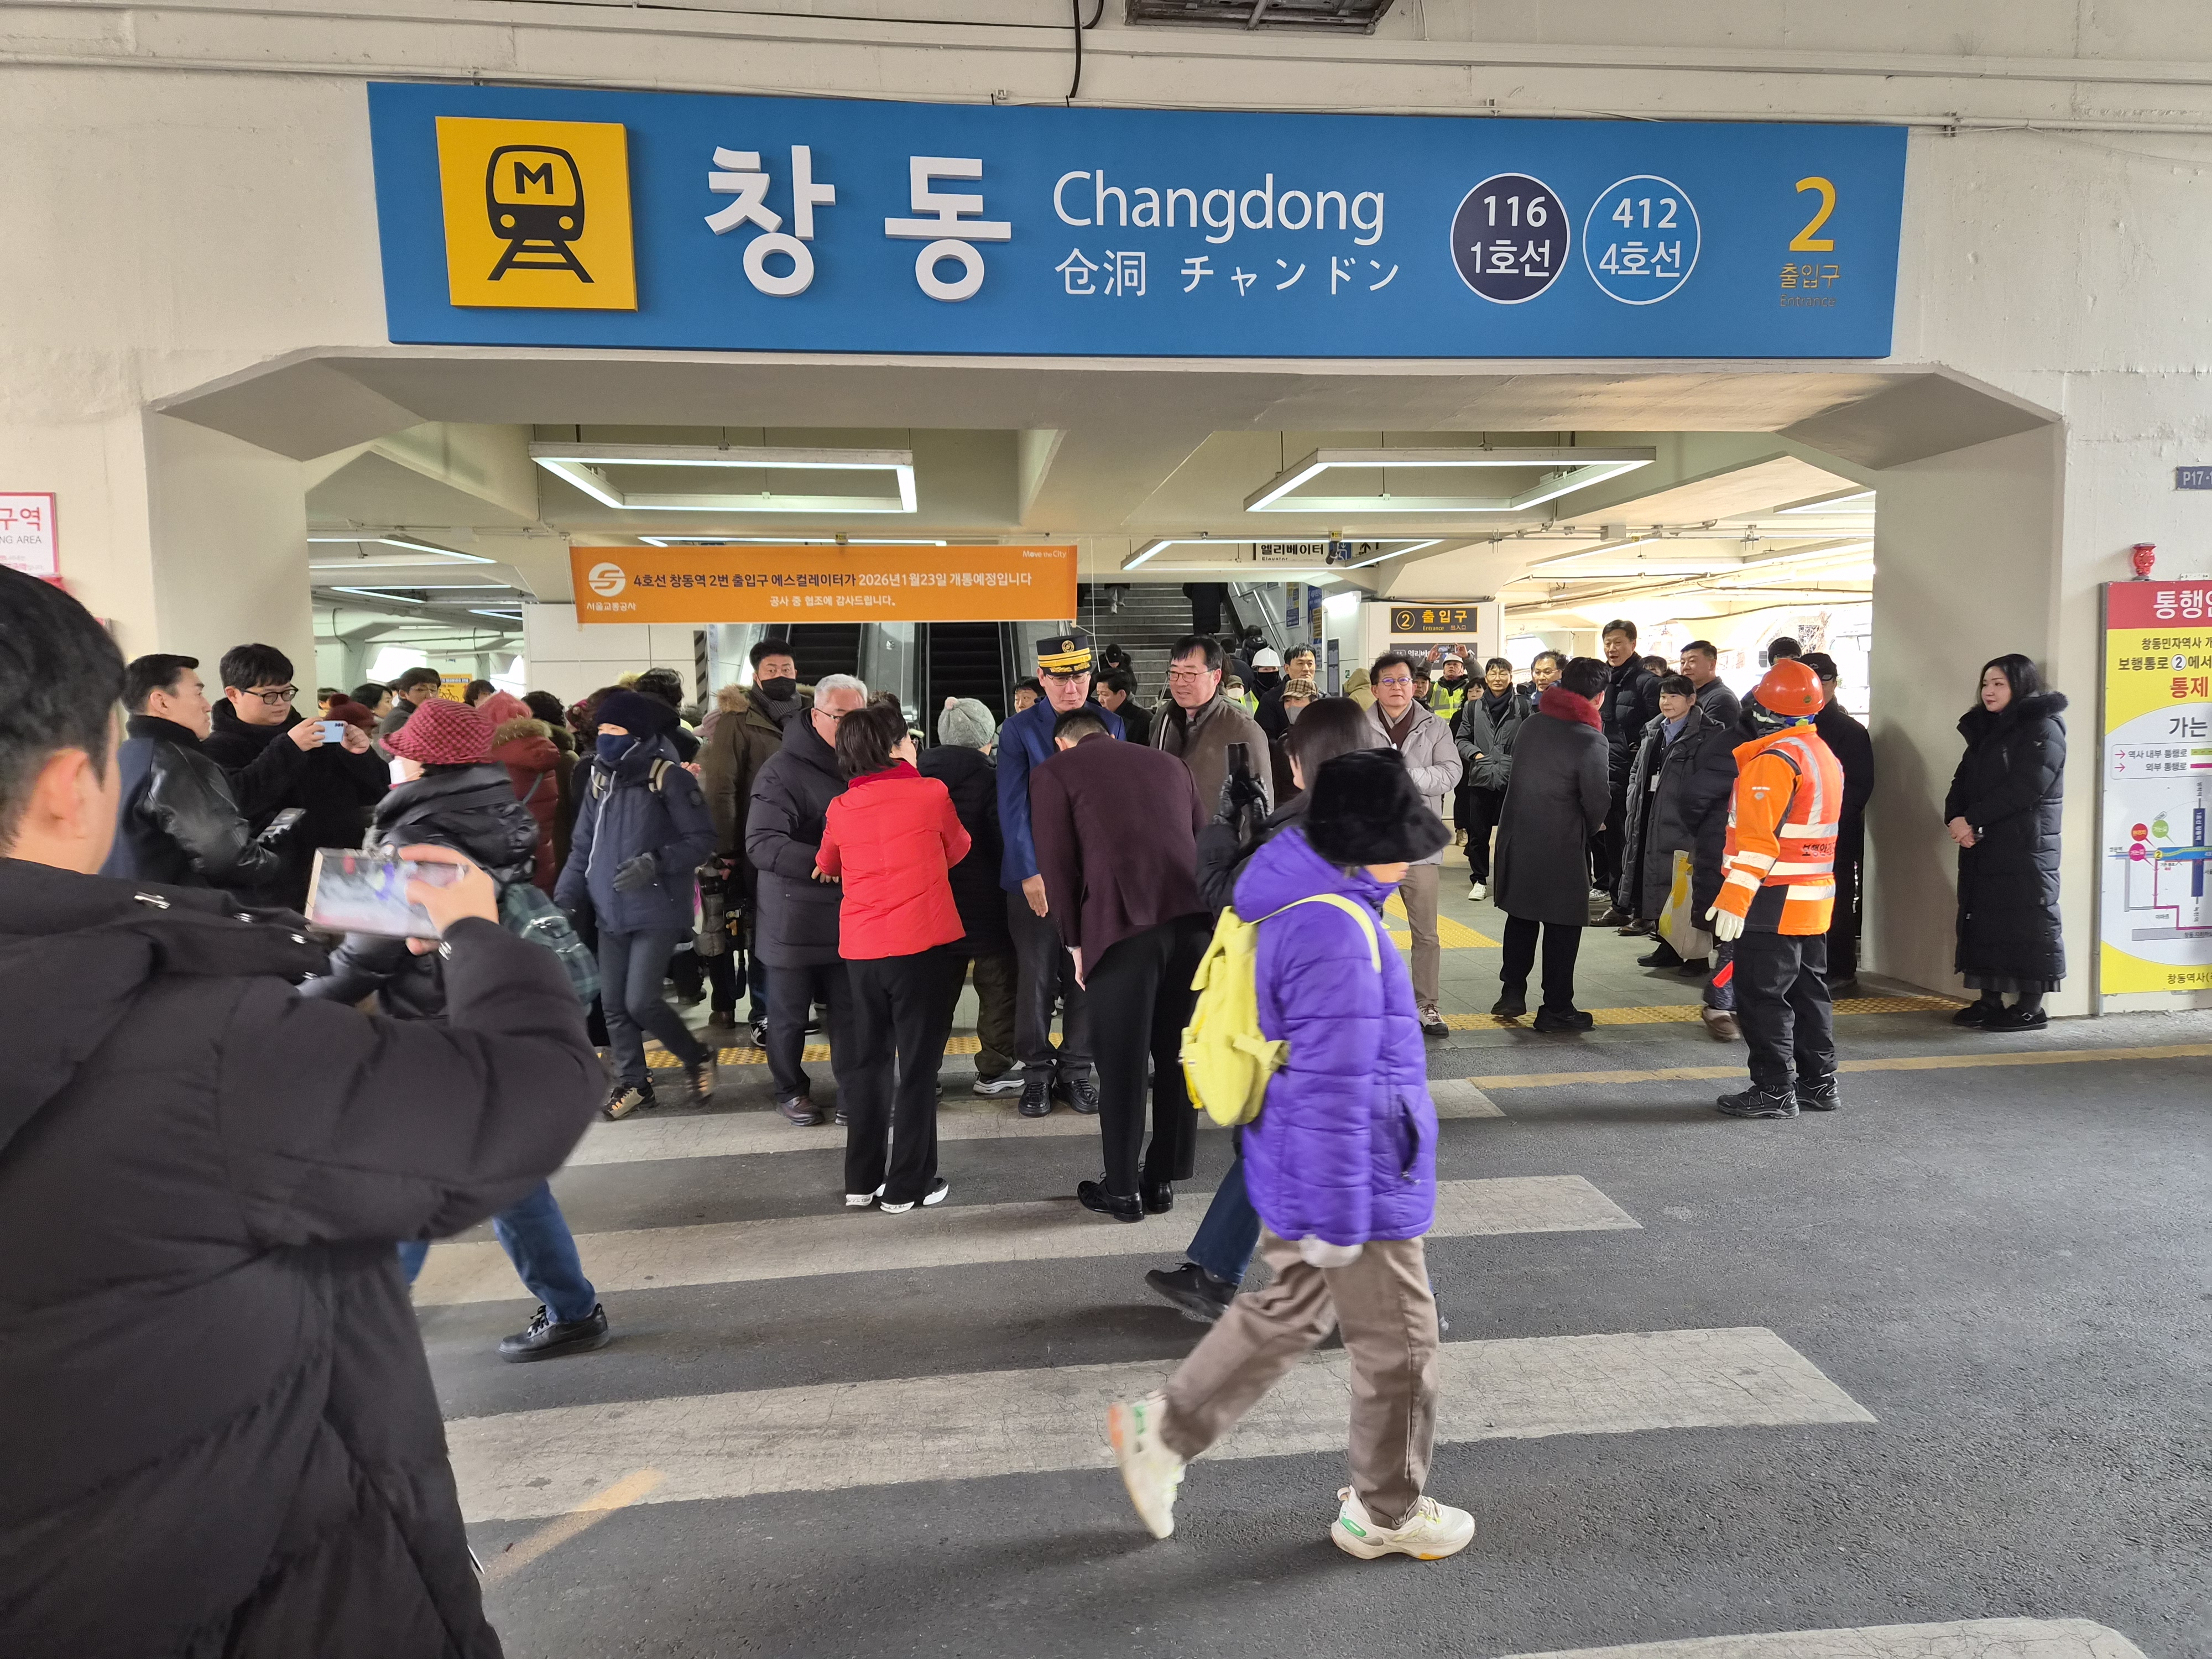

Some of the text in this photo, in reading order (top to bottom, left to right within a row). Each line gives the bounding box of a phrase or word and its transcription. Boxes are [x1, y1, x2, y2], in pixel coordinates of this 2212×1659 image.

[514, 161, 552, 195] M
[1053, 169, 1384, 246] Changdong
[1484, 195, 1547, 228] 116
[1612, 197, 1677, 229] 412
[1788, 176, 1837, 252] 2
[1470, 239, 1551, 278] 1호선
[1599, 240, 1681, 278] 4호선
[1055, 248, 1146, 296] 仓洞
[1181, 255, 1399, 296] チャンドン
[1779, 263, 1841, 289] 출입구
[1780, 294, 1837, 307] Entrance
[1261, 544, 1323, 555] 엘리베이터
[634, 575, 666, 587] 4호선
[670, 574, 706, 588] 창동역
[709, 575, 729, 587] 2번
[733, 574, 768, 587] 출입구
[771, 573, 856, 587] 에스컬레이터가
[950, 572, 1032, 587] 개통예정입니다
[586, 602, 637, 612] 서울교통공사
[770, 595, 896, 607] 공사 중 협조에 감사드립니다.
[1401, 610, 1467, 627] 2 출입구
[2142, 637, 2201, 650] 창동민자역사
[2170, 676, 2208, 698] 통제
[2169, 717, 2208, 738] 가는
[2128, 749, 2188, 759] 역사 내부 통행로
[2146, 762, 2187, 771] 외부 통행로
